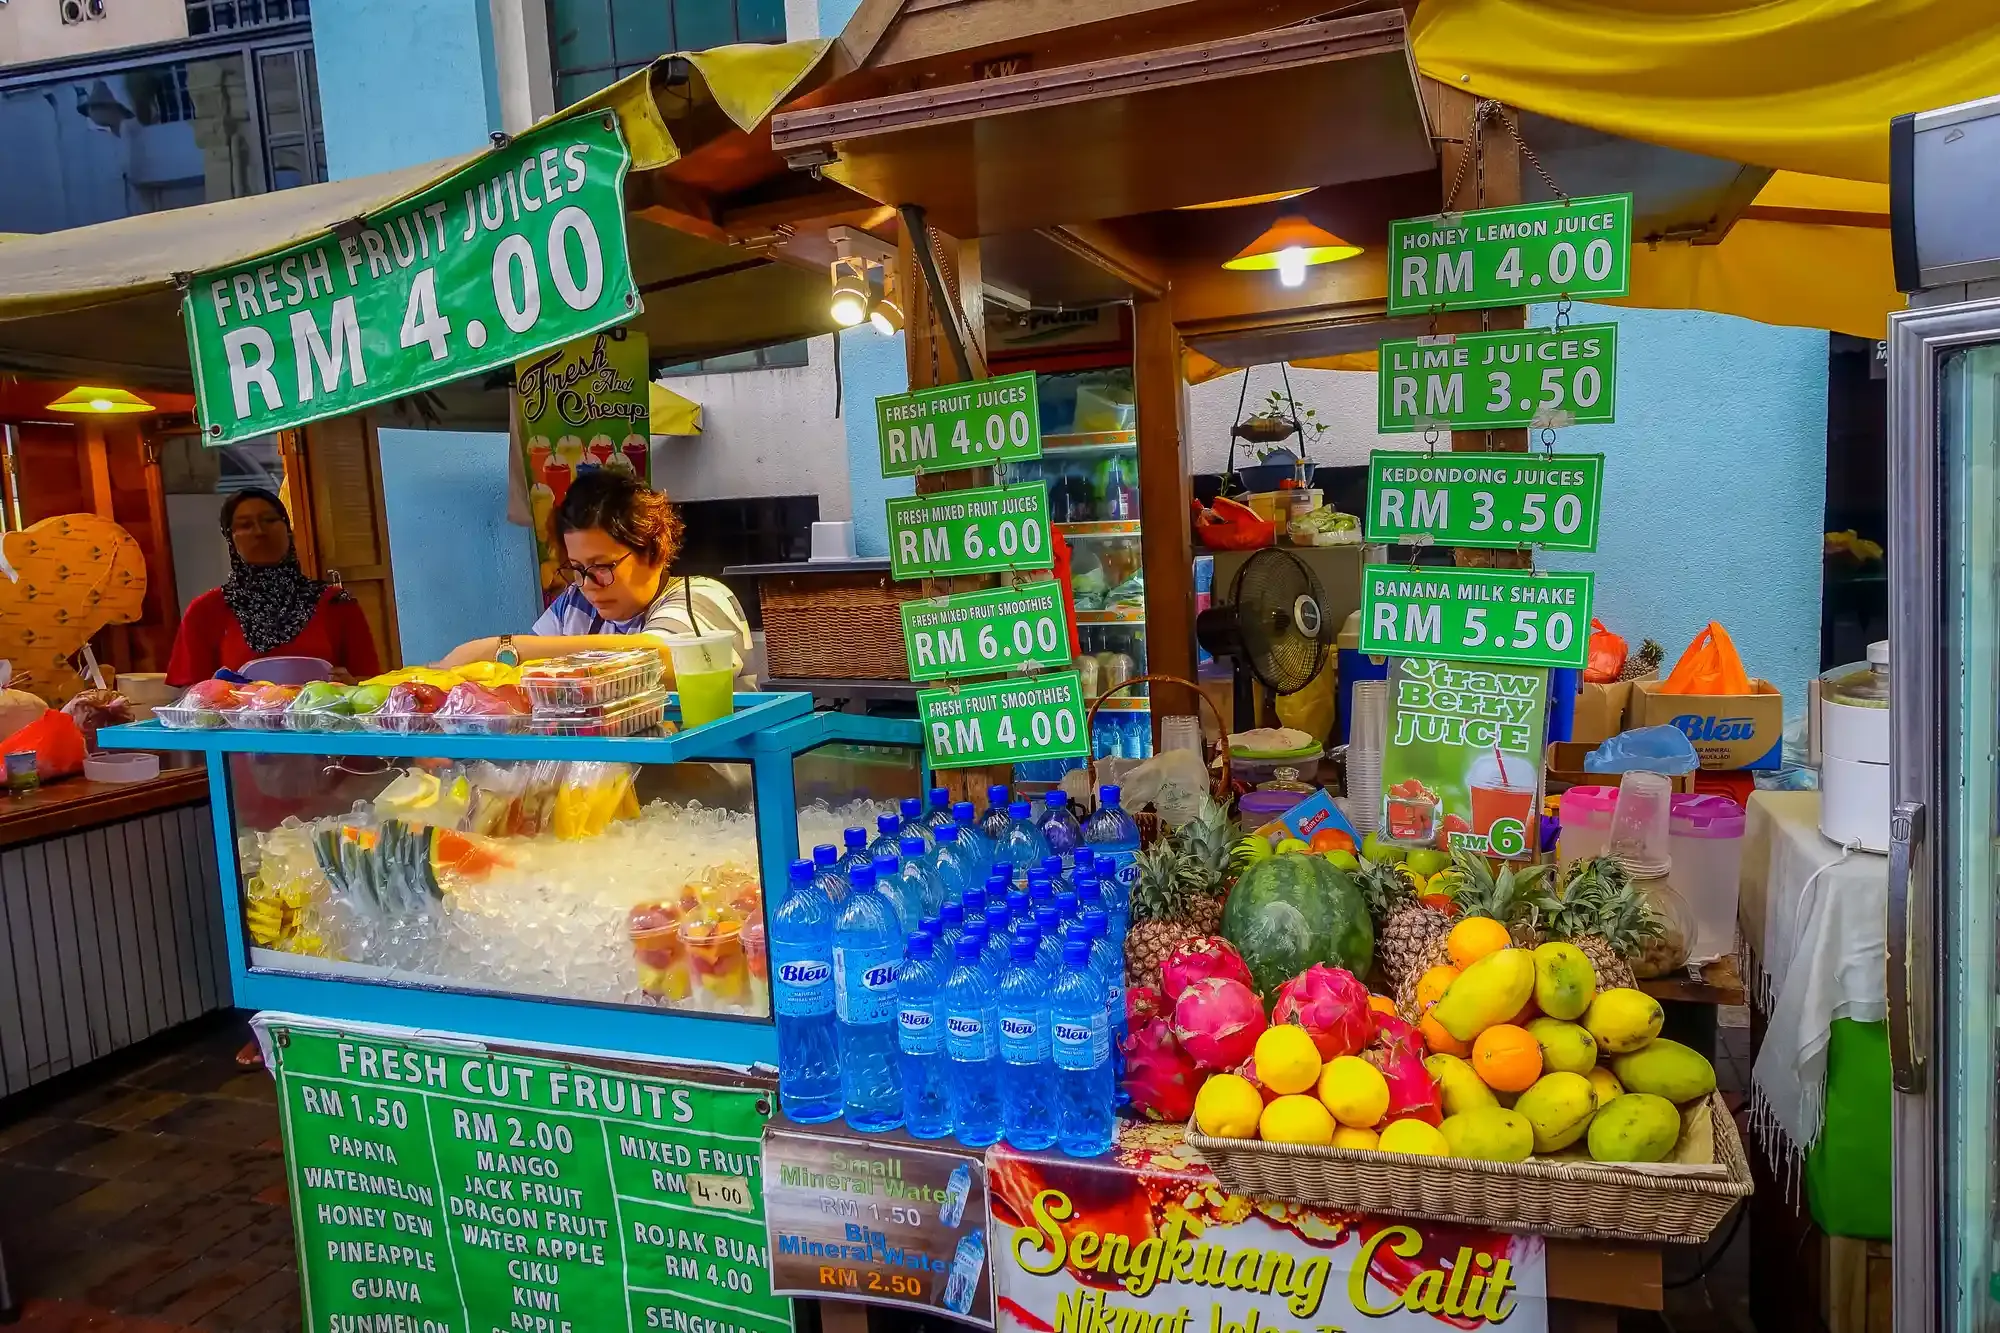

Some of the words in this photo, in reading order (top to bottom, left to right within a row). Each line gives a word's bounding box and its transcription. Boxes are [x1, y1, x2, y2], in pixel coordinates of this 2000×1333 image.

[211, 249, 332, 326] FRESH
[347, 201, 447, 287] FRUIT
[462, 144, 590, 242] JUICES
[1403, 228, 1469, 250] HONEY
[1476, 220, 1548, 242] LEMON
[1554, 213, 1614, 234] JUICE
[1401, 250, 1474, 297] RM
[1495, 238, 1613, 288] 4.00
[222, 295, 367, 420] RM
[400, 206, 604, 360] 4.00
[1393, 348, 1469, 370] LIME
[1481, 338, 1601, 365] JUICES
[518, 335, 608, 421] Fresh
[592, 368, 634, 392] And
[1393, 373, 1464, 417] RM
[1485, 365, 1601, 413] 3.50
[556, 390, 648, 426] Cheap
[886, 403, 927, 422] FRESH
[931, 395, 971, 415] FRUIT
[976, 386, 1026, 408] JUICES
[888, 423, 938, 464] RM
[951, 410, 1029, 455] 4.00
[1381, 468, 1507, 484] KEDONDONG
[1513, 470, 1584, 486] JUICES
[897, 509, 929, 526] FRESH
[932, 504, 964, 522] MIXED
[968, 500, 999, 518] FRUIT
[1001, 496, 1038, 514] JUICES
[1379, 489, 1448, 530] RM
[1469, 491, 1582, 534] 3.50
[900, 526, 951, 565] RM
[963, 518, 1041, 560] 6.00
[1375, 581, 1450, 599] BANANA
[1457, 584, 1504, 602] MILK
[1510, 586, 1575, 605] SHAKE
[911, 614, 938, 627] FRESH
[940, 608, 968, 624] MIXED
[970, 605, 995, 620] FRUIT
[998, 596, 1053, 616] SMOOTHIES
[1373, 602, 1441, 644] RM
[1462, 608, 1574, 651] 5.50
[915, 628, 967, 667] RM
[978, 616, 1057, 660] 6.00
[1400, 658, 1539, 696] Straw
[928, 702, 962, 718] FRESH
[966, 694, 997, 712] FRUIT
[1001, 685, 1071, 710] SMOOTHIES
[1397, 680, 1535, 724] Berry
[931, 717, 985, 756] RM
[997, 708, 1076, 749] 4.00
[1394, 711, 1530, 753] JUICE
[1669, 714, 1755, 741] Bleu
[1448, 831, 1488, 851] RM
[1490, 817, 1525, 856] 6
[780, 965, 829, 982] Bleu
[865, 966, 901, 987] Ble
[900, 1012, 931, 1025] Bleu
[949, 1018, 979, 1032] Bleu
[1000, 1020, 1035, 1034] Bleu
[1055, 1025, 1089, 1040] Bleu
[338, 1043, 447, 1089] FRESH
[461, 1061, 534, 1101] CUT
[549, 1071, 694, 1123] FRUITS
[302, 1085, 344, 1118] RM
[351, 1093, 408, 1131] 1.50
[453, 1108, 498, 1143] RM
[507, 1117, 572, 1154] 2.00
[329, 1134, 398, 1165] PAPAYA
[476, 1151, 559, 1179] MANGO
[619, 1135, 692, 1167] MIXED
[832, 1152, 901, 1178] Small
[303, 1167, 434, 1207] WATERMELON
[465, 1175, 514, 1201] JACK
[521, 1182, 583, 1210] FRUIT
[652, 1169, 687, 1194] RM
[780, 1164, 874, 1195] Mineral
[884, 1176, 959, 1204] Water
[317, 1204, 386, 1228] HONEY
[393, 1212, 433, 1238] DEW
[450, 1196, 538, 1229] DRAGON
[546, 1212, 608, 1239] FRUIT
[819, 1196, 860, 1219] RM
[869, 1204, 922, 1226] 1.50
[461, 1224, 528, 1254] WATER
[536, 1238, 605, 1266] APPLE
[634, 1222, 708, 1254] ROJAK
[779, 1235, 874, 1263] Mineral
[878, 1246, 957, 1273] Water
[845, 1223, 888, 1250] Big
[1012, 1189, 1332, 1318] Sengkuang
[328, 1241, 436, 1272] PINEAPPLE
[508, 1260, 559, 1285] CIKU
[1348, 1225, 1518, 1322] Calit
[352, 1278, 422, 1304] GUAVA
[665, 1255, 699, 1280] RM
[707, 1264, 753, 1294] 4.00
[819, 1266, 858, 1288] RM
[868, 1272, 921, 1296] 2.50
[513, 1286, 561, 1313] KIWI
[1053, 1287, 1194, 1333] Nikmat
[511, 1311, 572, 1333] APPLE
[646, 1306, 765, 1333] SENGK
